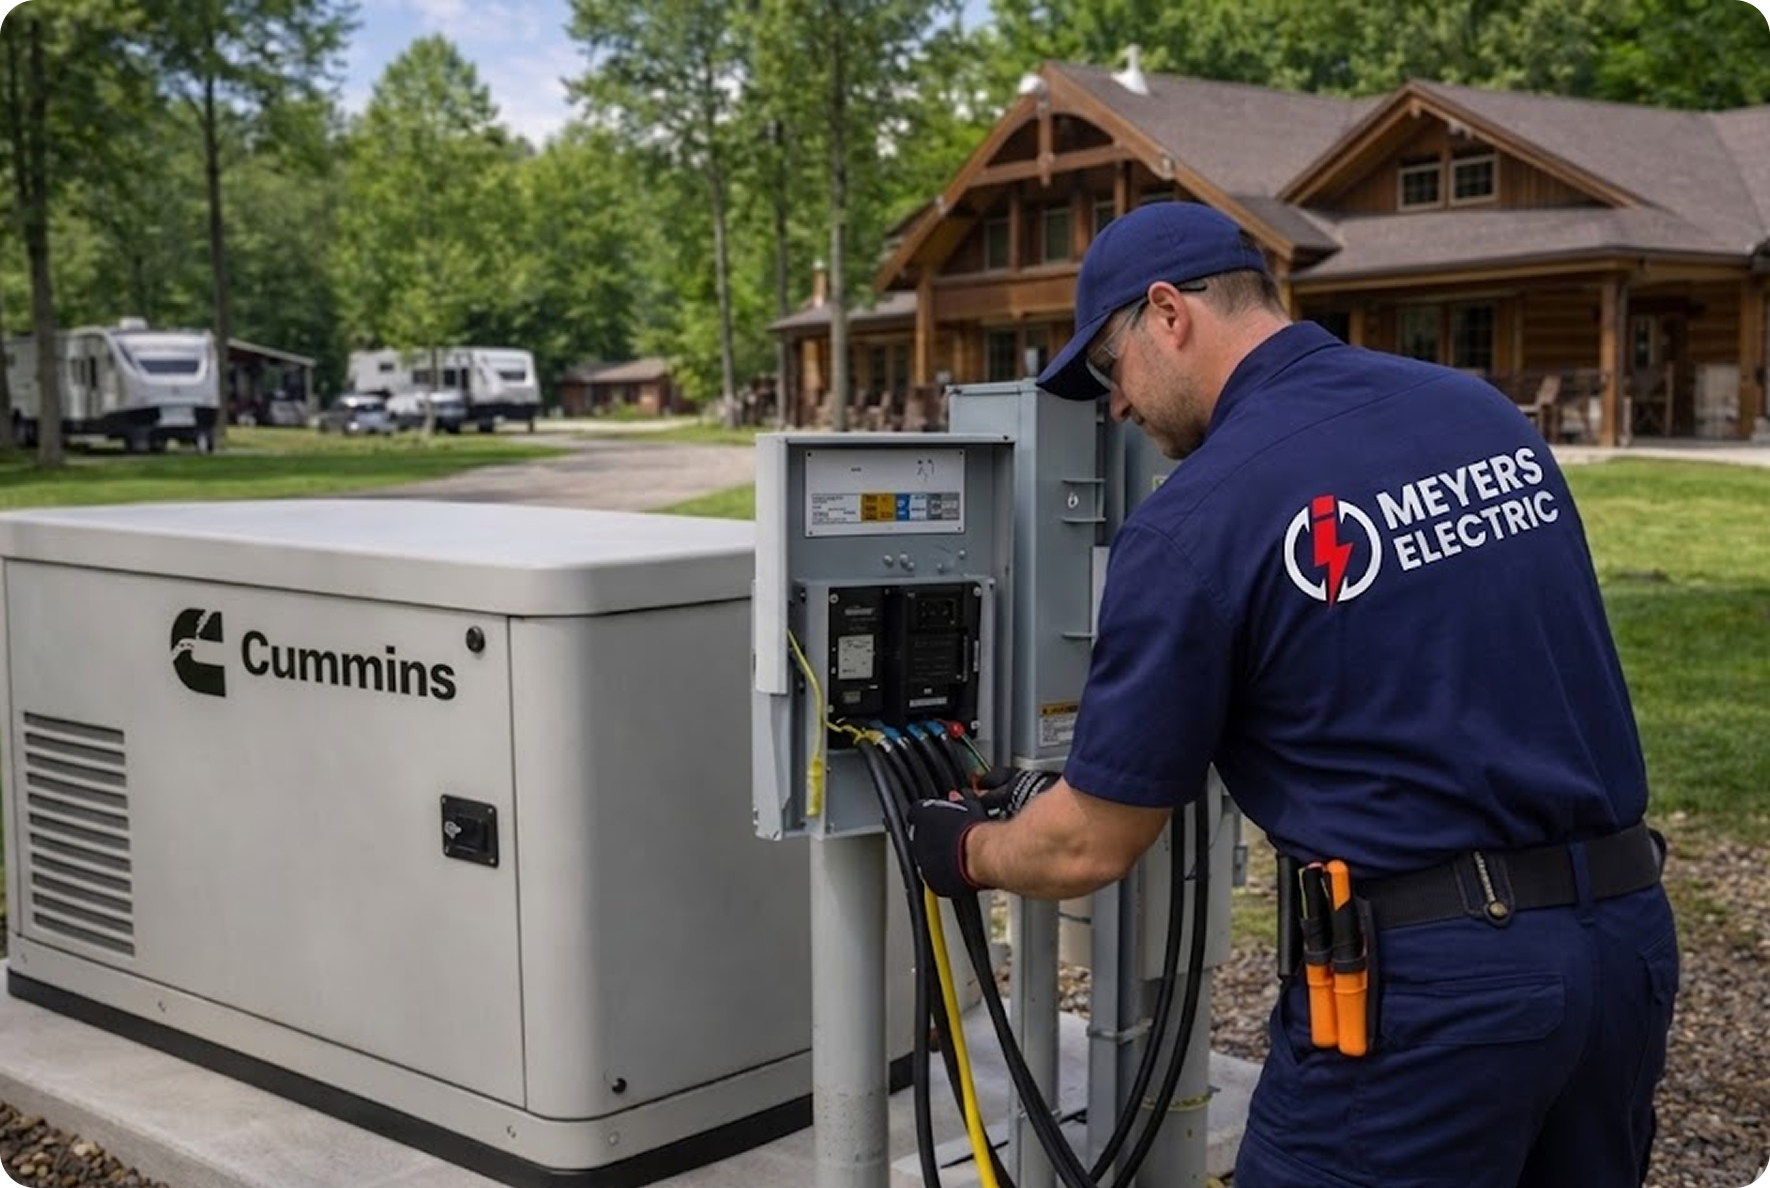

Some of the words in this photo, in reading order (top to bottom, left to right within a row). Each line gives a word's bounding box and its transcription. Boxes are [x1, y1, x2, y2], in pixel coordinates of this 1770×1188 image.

[1376, 447, 1544, 530] MEYERS
[1393, 490, 1559, 571] ELECTRIC
[241, 630, 456, 701] Cummins
